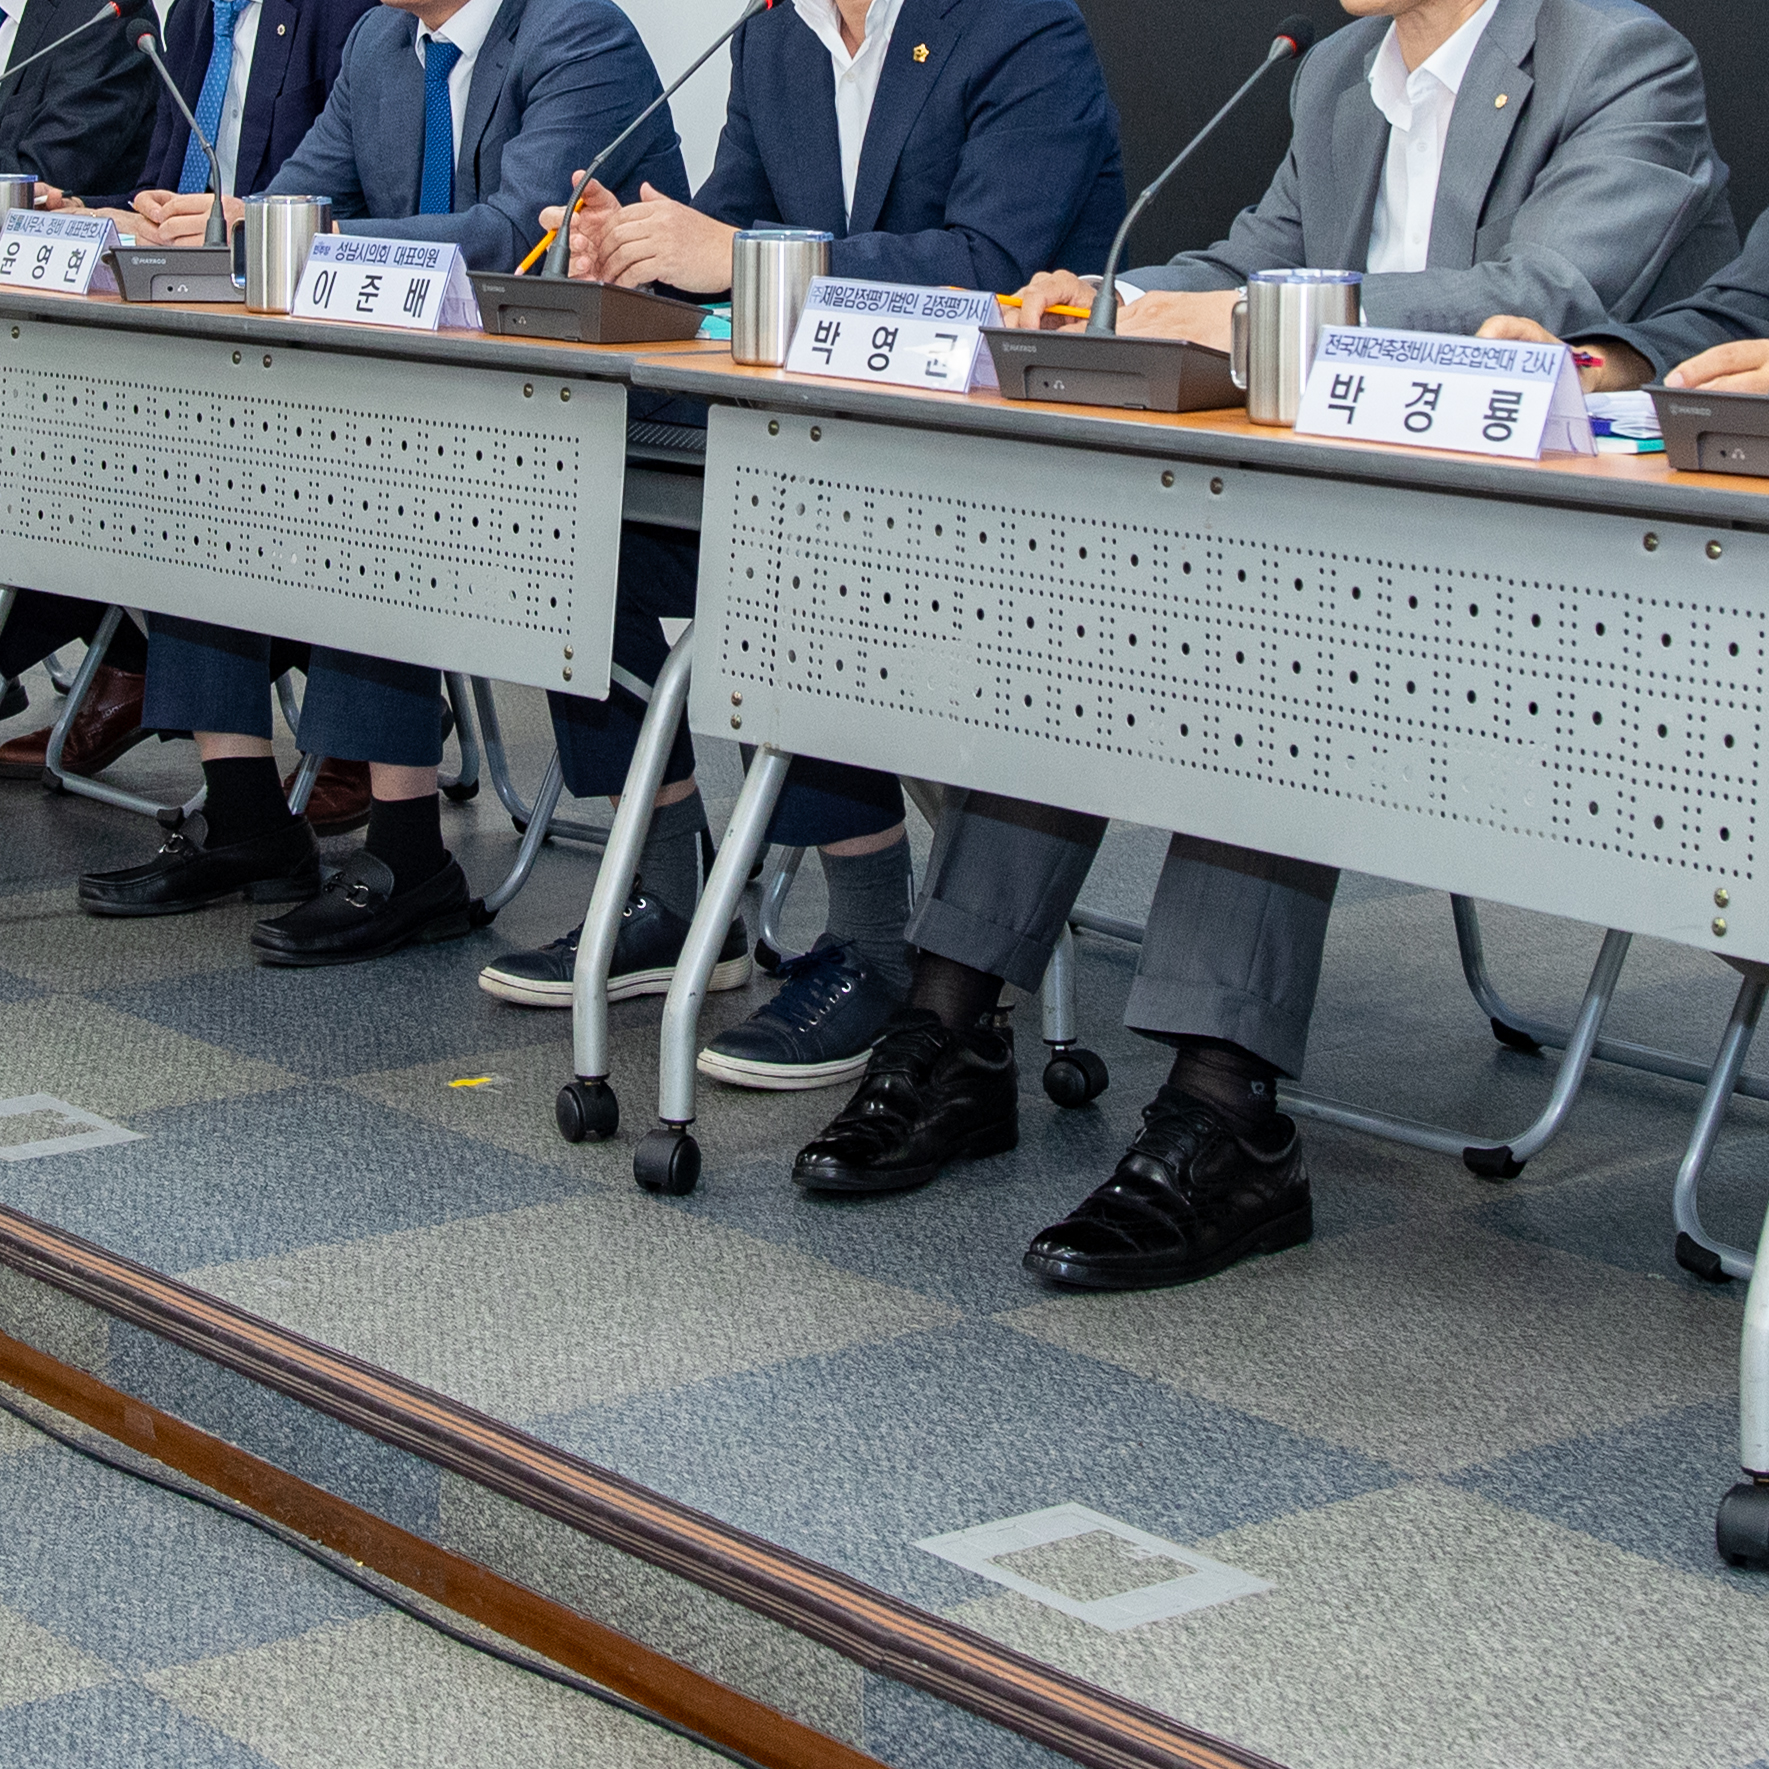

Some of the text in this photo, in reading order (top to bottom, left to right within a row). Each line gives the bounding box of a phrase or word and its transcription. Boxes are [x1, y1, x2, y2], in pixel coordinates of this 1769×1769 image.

[335, 241, 391, 264] 성남시의회
[393, 245, 440, 269] 대표의원
[921, 295, 988, 322] 감정평가사
[1325, 334, 1556, 376] 전국재건축정비사업조합연대 간사
